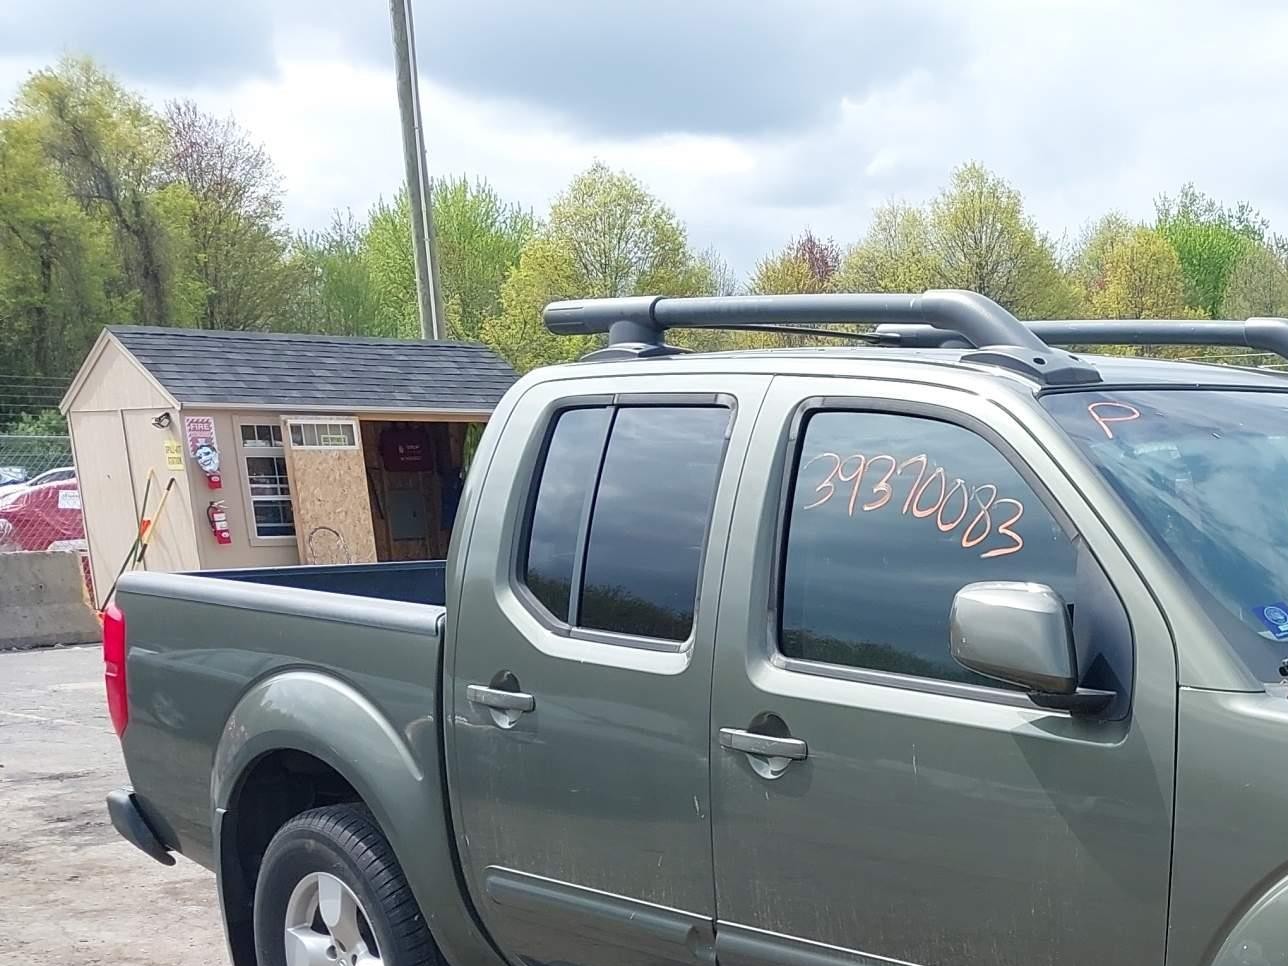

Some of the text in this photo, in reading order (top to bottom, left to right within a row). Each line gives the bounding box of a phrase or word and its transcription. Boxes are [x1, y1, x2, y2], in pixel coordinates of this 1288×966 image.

[191, 422, 210, 430] FIRE
[1088, 402, 1140, 439] P
[803, 452, 1025, 559] 39370083
